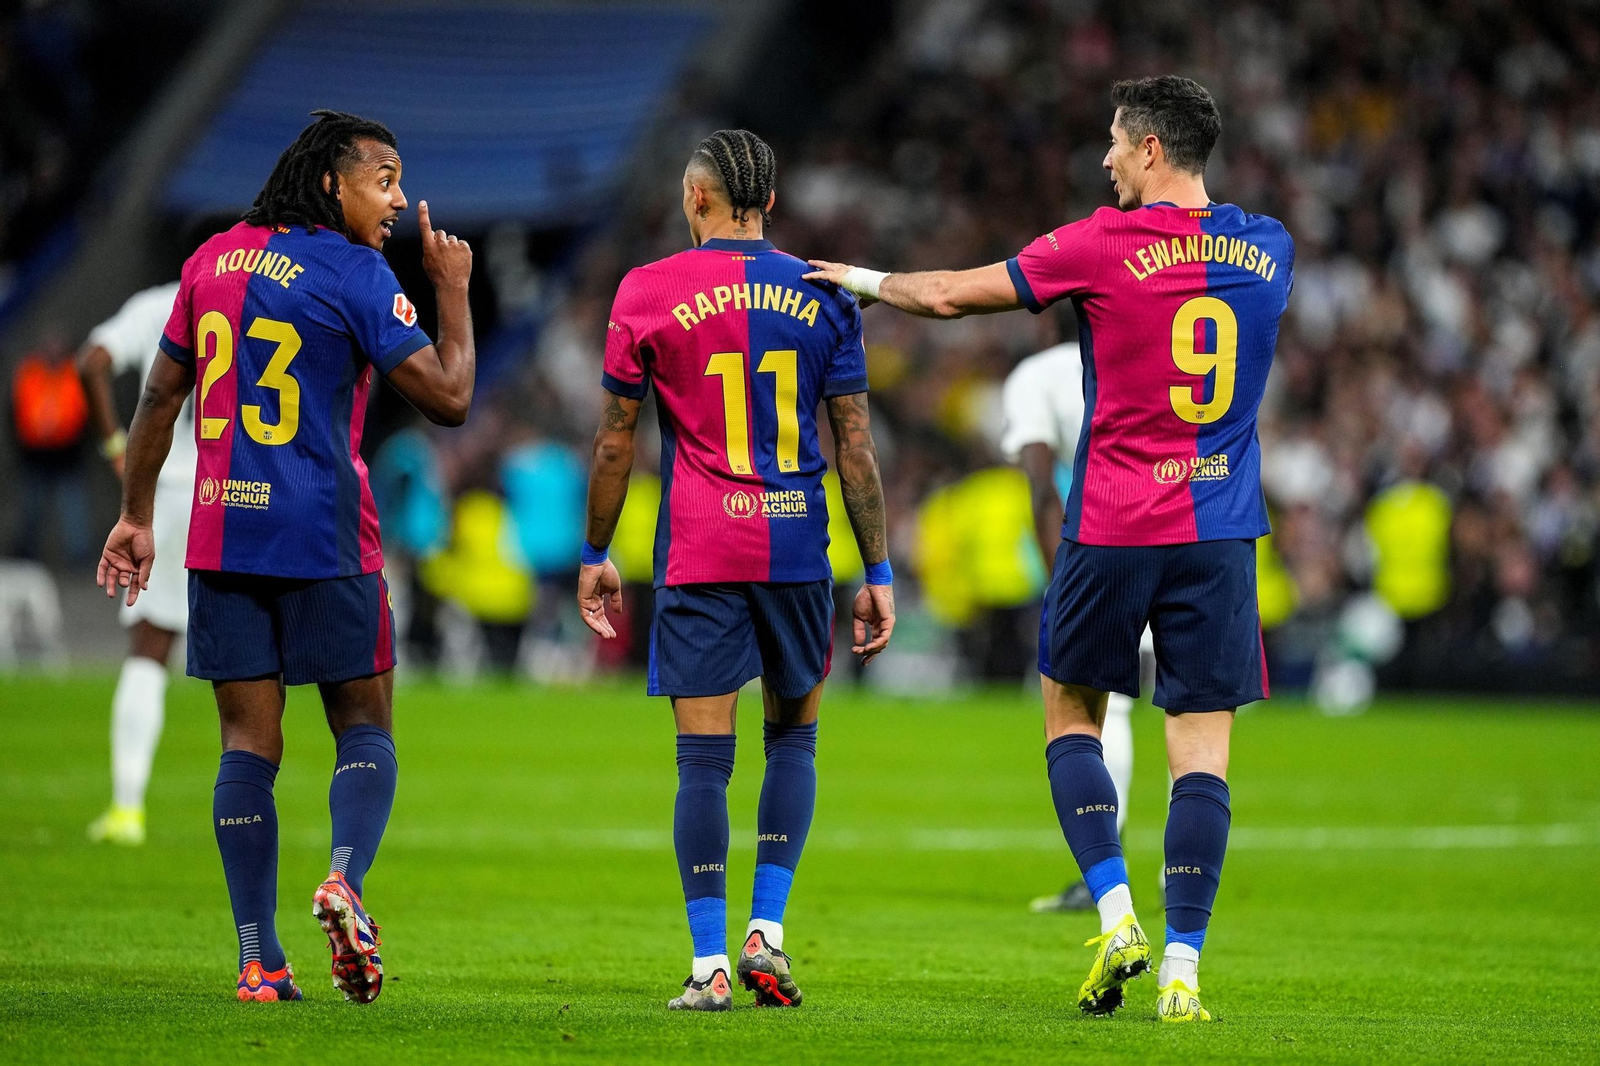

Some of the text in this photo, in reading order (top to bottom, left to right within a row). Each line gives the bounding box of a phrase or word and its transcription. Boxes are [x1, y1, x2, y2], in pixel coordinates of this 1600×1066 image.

[215, 248, 305, 289] KOUNDE
[1123, 234, 1277, 282] LEWANDOWSKI
[671, 283, 821, 332] RAPHINHA
[197, 310, 302, 445] 23
[1169, 296, 1238, 424] 9
[703, 350, 800, 475] 11
[220, 490, 270, 505] ACNUR
[222, 479, 271, 494] UNHCR
[759, 490, 805, 503] UNHCR
[761, 501, 807, 513] ACNUR
